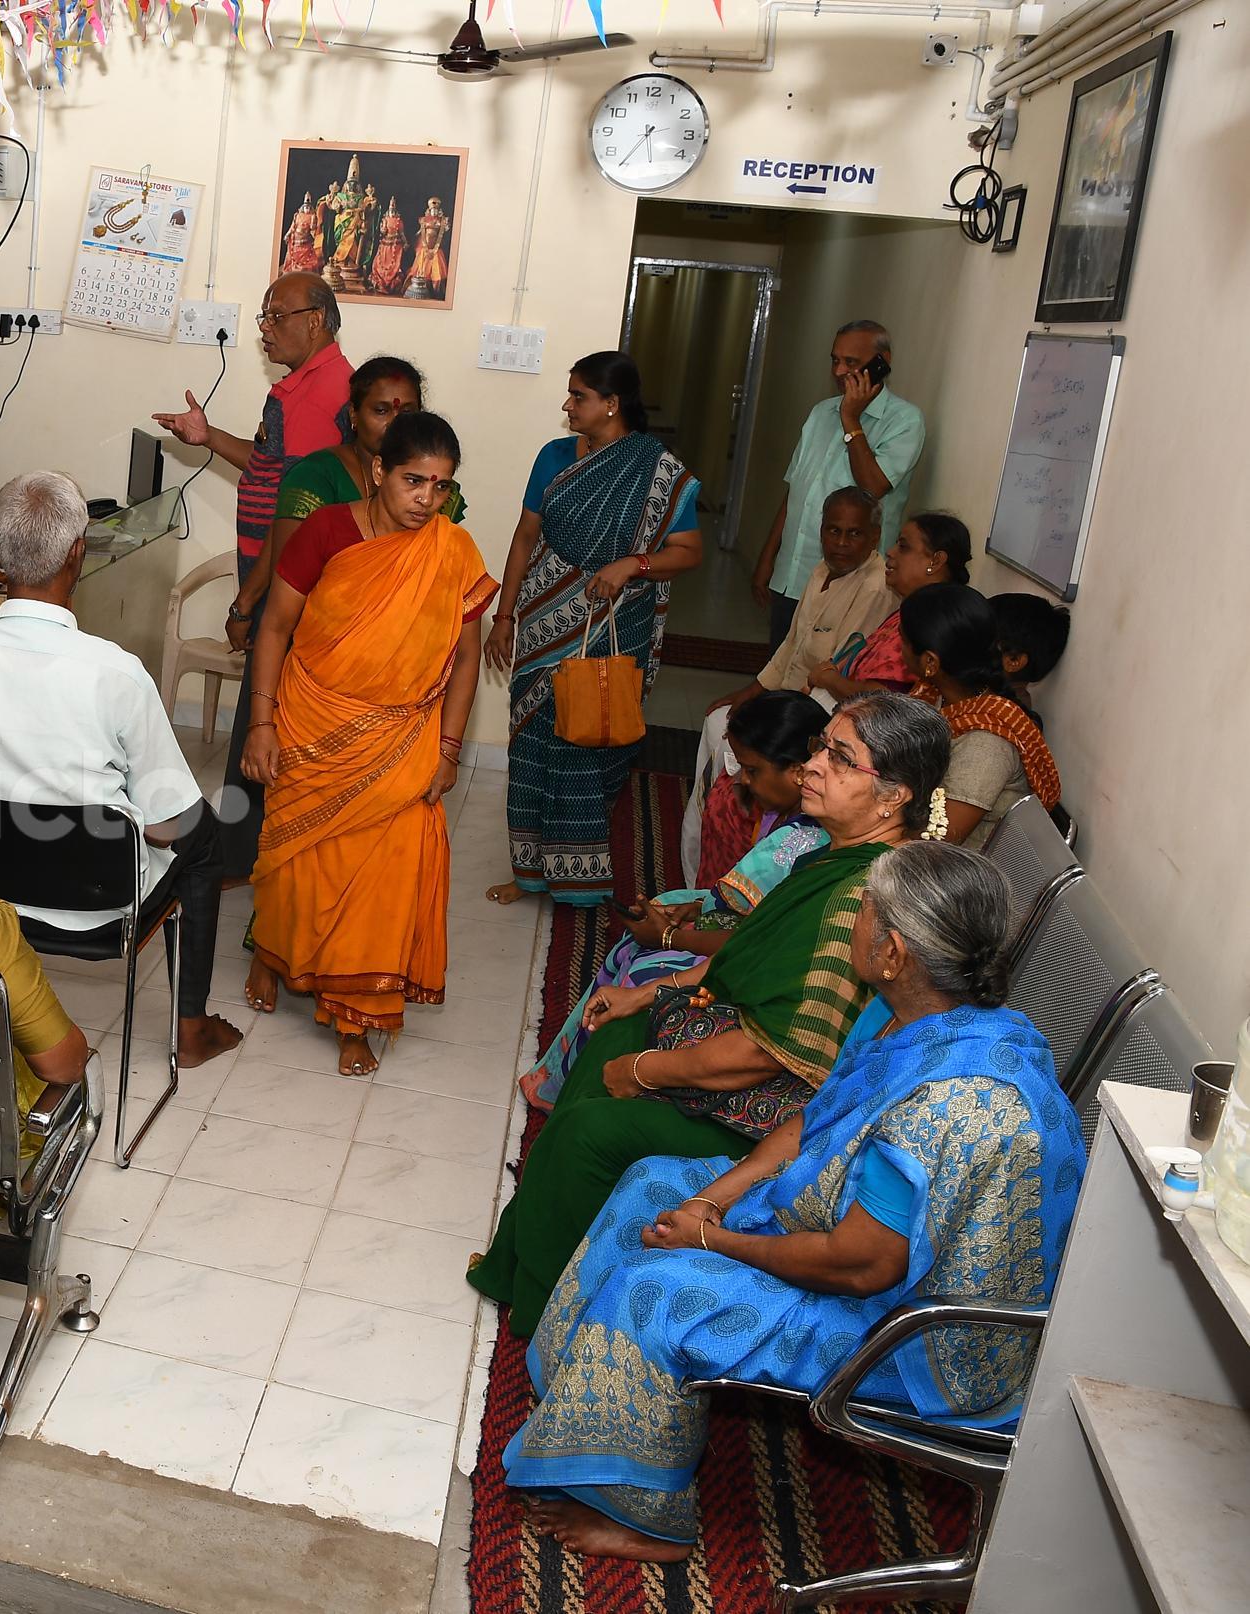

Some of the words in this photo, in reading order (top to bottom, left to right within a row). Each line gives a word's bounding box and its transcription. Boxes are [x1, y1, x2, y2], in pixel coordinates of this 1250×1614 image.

[627, 92, 638, 103] 11
[645, 86, 662, 98] 12
[669, 94, 675, 105] 1
[610, 107, 627, 118] 10
[679, 109, 691, 120] 2
[602, 126, 614, 137] 9
[683, 129, 695, 140] 3
[605, 146, 617, 157] 8
[674, 149, 687, 160] 4
[743, 159, 875, 185] RECEPTION
[149, 182, 173, 192] STORES
[113, 259, 117, 268] 1
[126, 262, 132, 271] 2
[140, 265, 147, 273] 3
[155, 267, 161, 275] 4
[170, 270, 176, 278] 5
[81, 266, 87, 275] 6
[96, 269, 102, 278] 7
[109, 272, 116, 280] 8
[124, 274, 130, 282] 9
[136, 276, 147, 286] 10
[151, 279, 161, 289] 11
[165, 282, 176, 291] 12
[77, 278, 87, 288] 13
[90, 281, 101, 290] 14
[105, 283, 115, 293] 15
[119, 286, 130, 296] 16
[134, 289, 144, 298] 17
[148, 291, 159, 301] 18
[163, 294, 173, 304] 19
[73, 291, 85, 300] 20
[88, 293, 98, 303] 21
[102, 296, 113, 306] 22
[116, 299, 127, 308] 23
[130, 302, 142, 311] 24
[145, 304, 156, 314] 25
[159, 307, 170, 316] 26
[71, 303, 83, 312] 27
[85, 306, 97, 315] 28
[99, 308, 111, 317] 29
[113, 311, 125, 321] 30
[128, 314, 139, 323] 31
